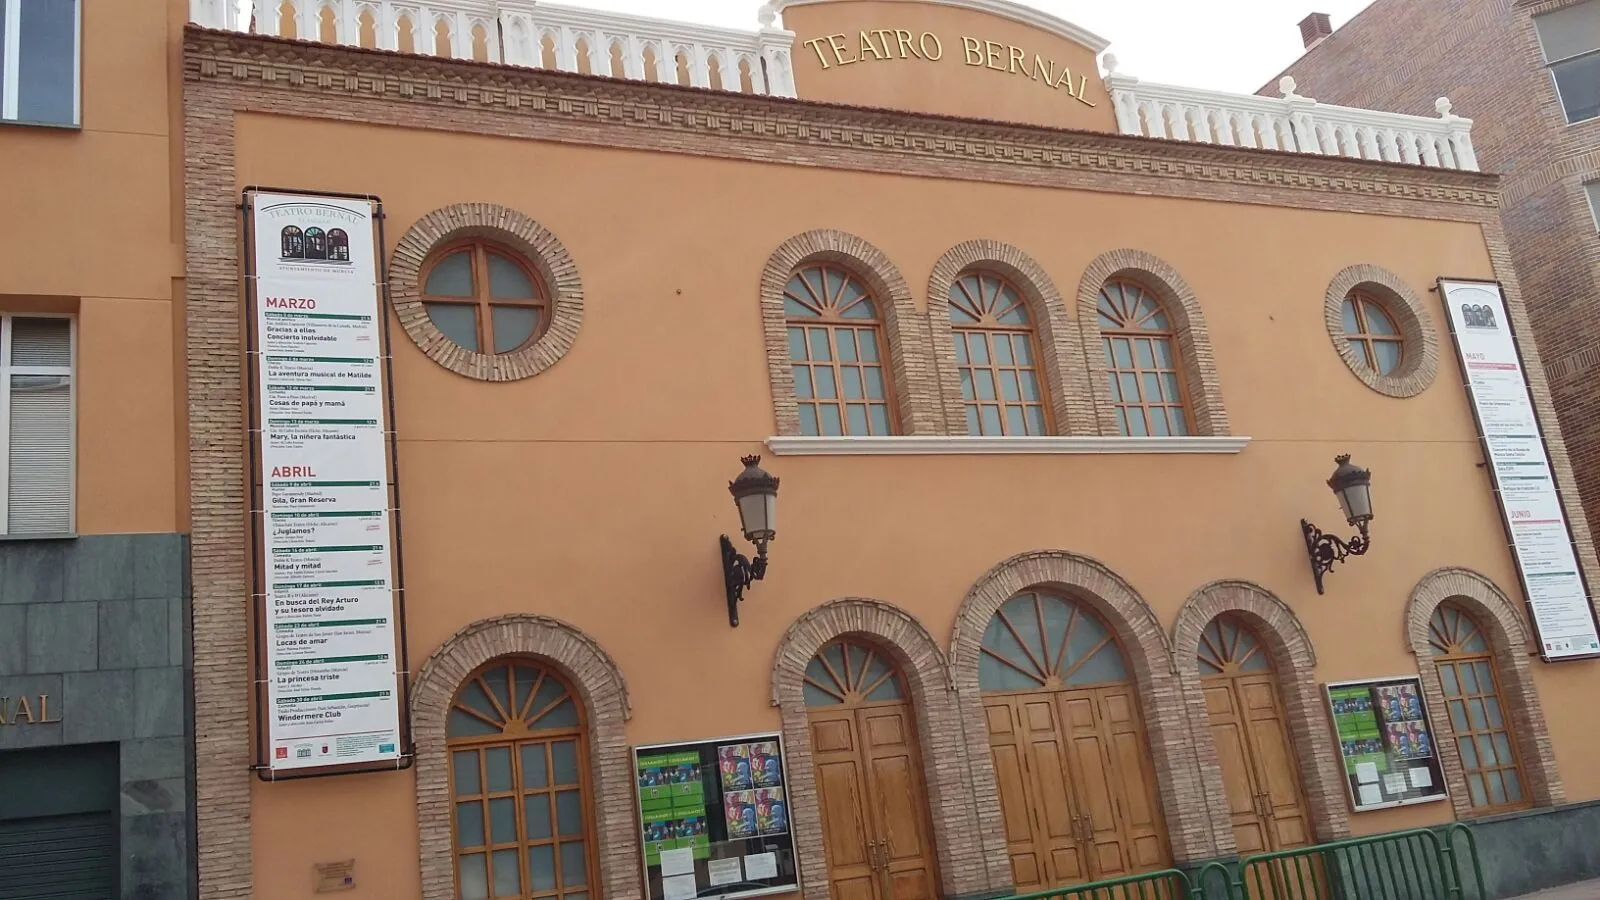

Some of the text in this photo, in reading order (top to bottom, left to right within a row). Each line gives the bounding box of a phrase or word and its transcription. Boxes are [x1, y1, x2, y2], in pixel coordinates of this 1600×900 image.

[804, 29, 1096, 107] TEATRO BERNAL
[269, 208, 360, 223] TEATRO BERNAL
[266, 297, 316, 309] MARZO
[271, 466, 316, 477] ABRIL
[1511, 510, 1531, 519] JUNIO
[288, 675, 318, 684] princesa
[278, 713, 323, 721] Windermere
